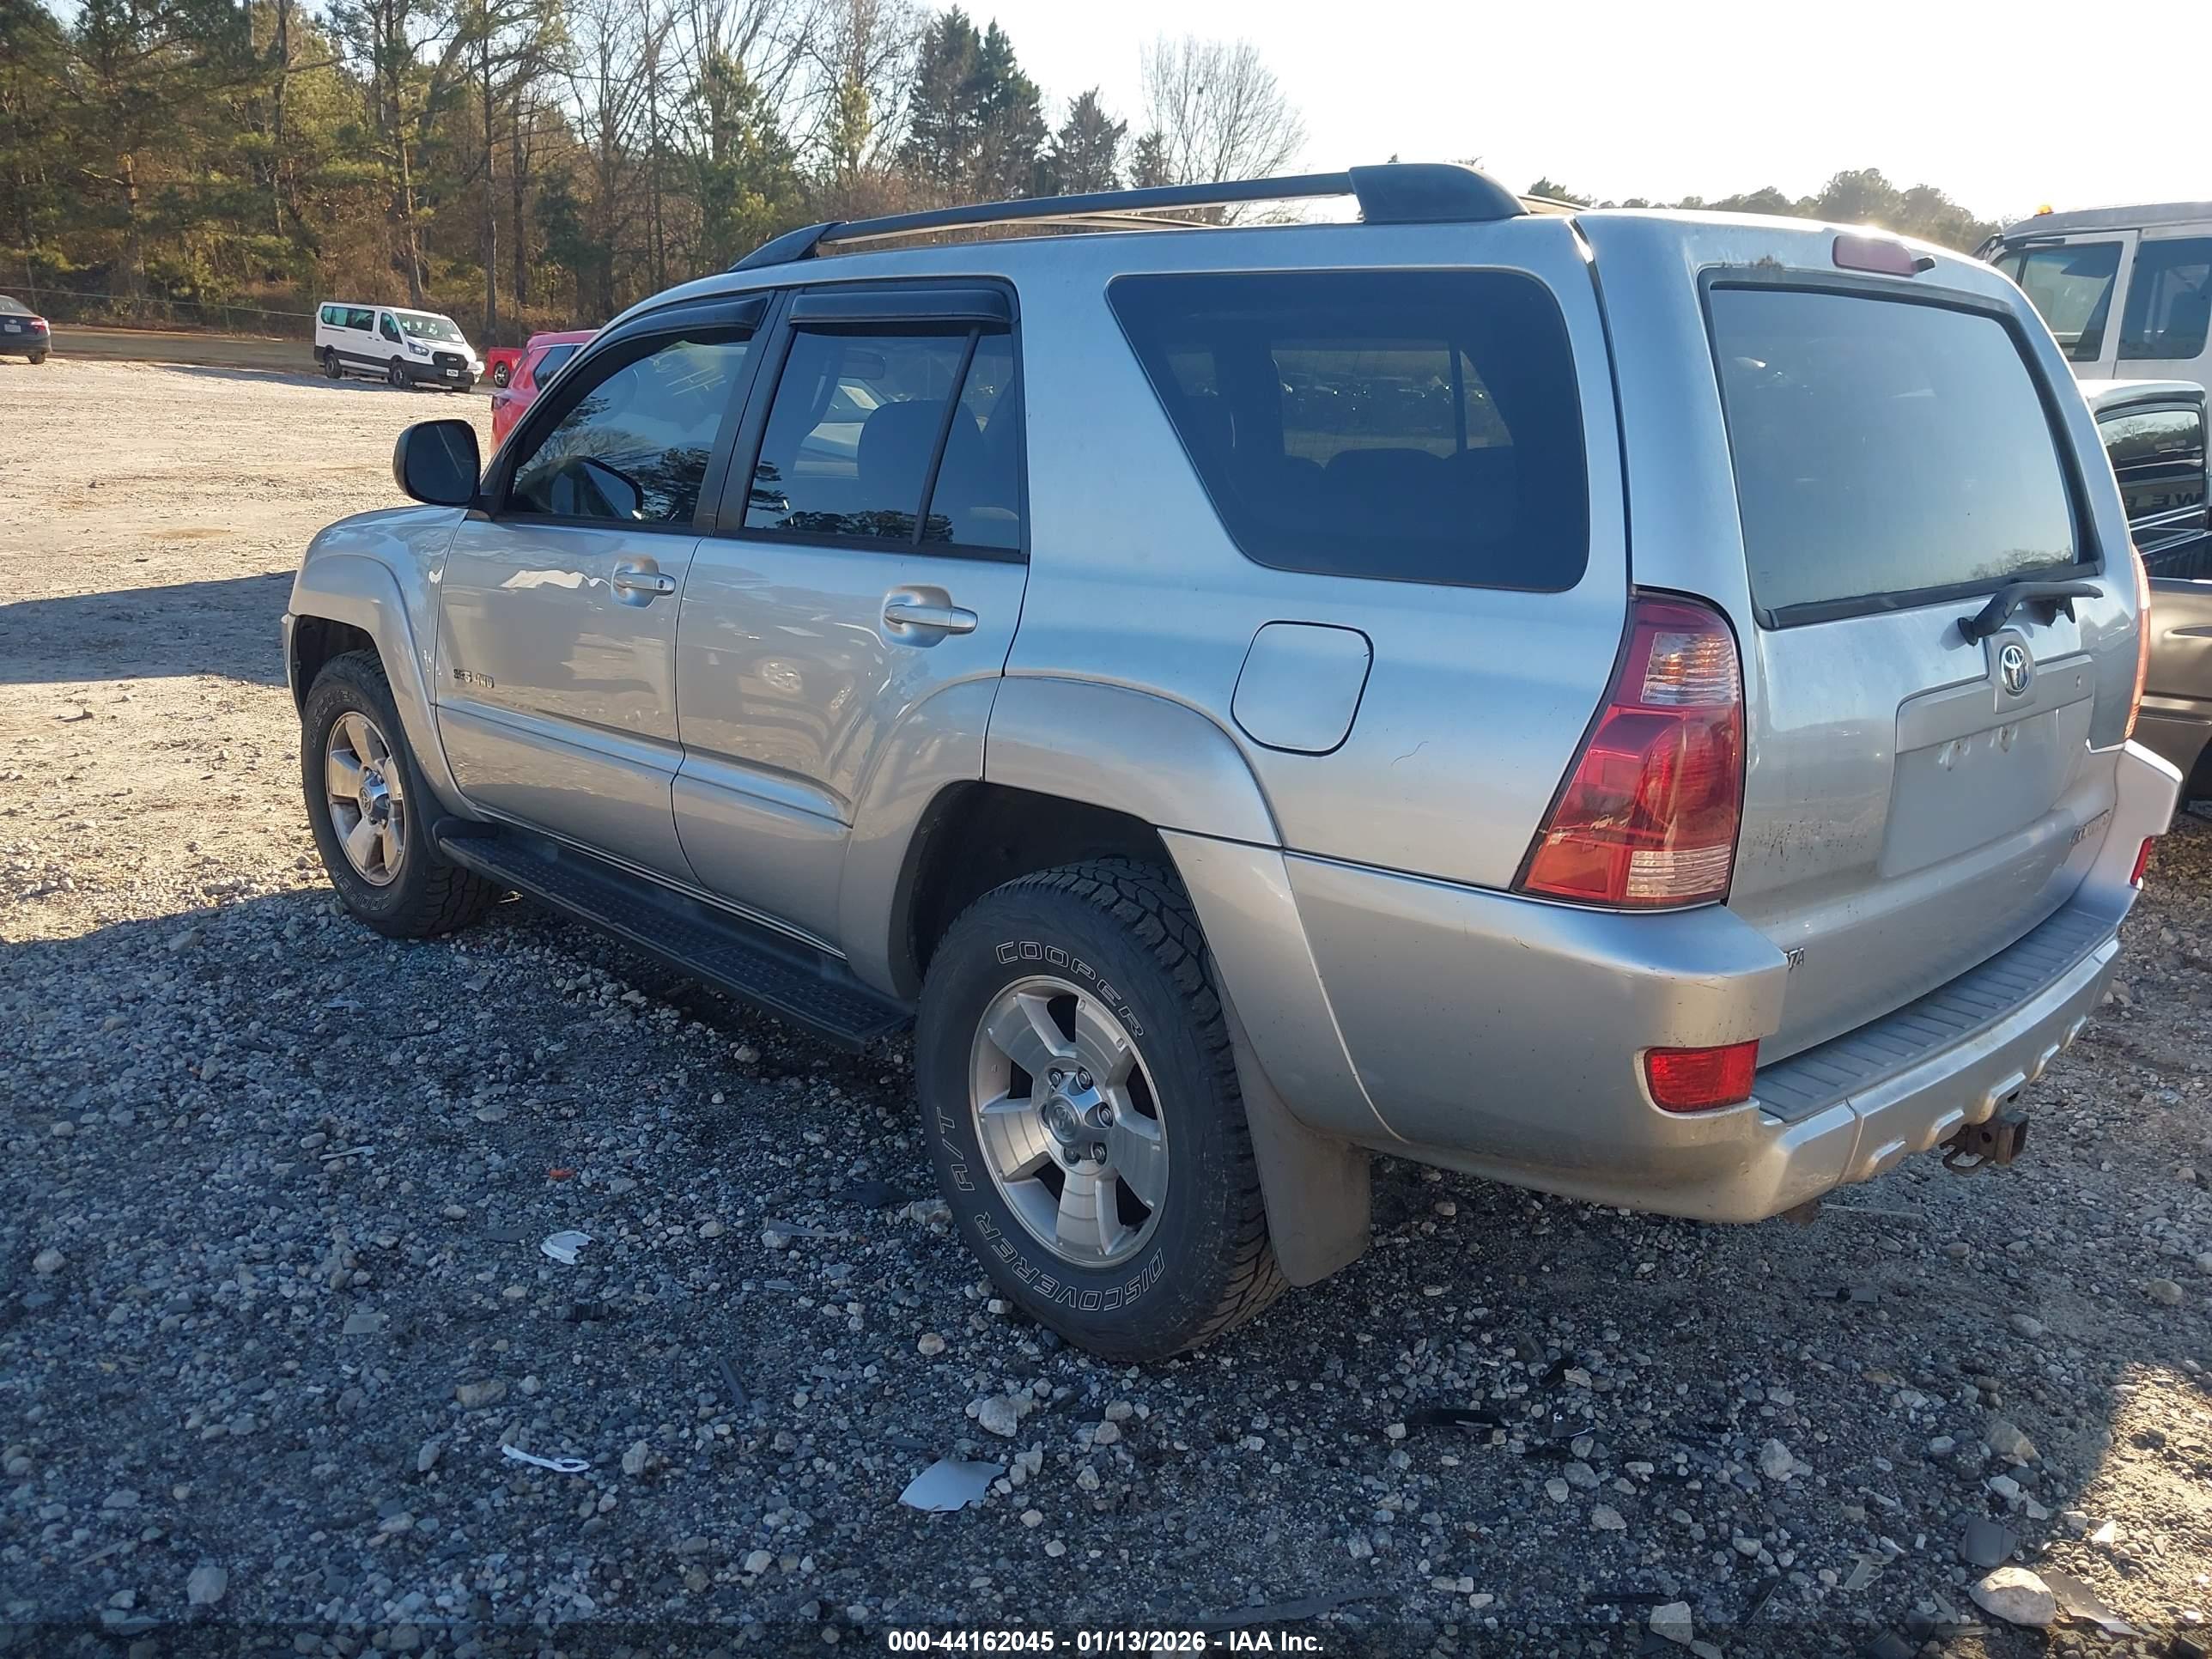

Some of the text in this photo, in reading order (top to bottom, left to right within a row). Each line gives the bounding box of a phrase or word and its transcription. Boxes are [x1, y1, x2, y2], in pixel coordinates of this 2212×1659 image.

[995, 940, 1145, 1037] COOPER
[936, 1106, 1166, 1311] DISCOVERER A/T
